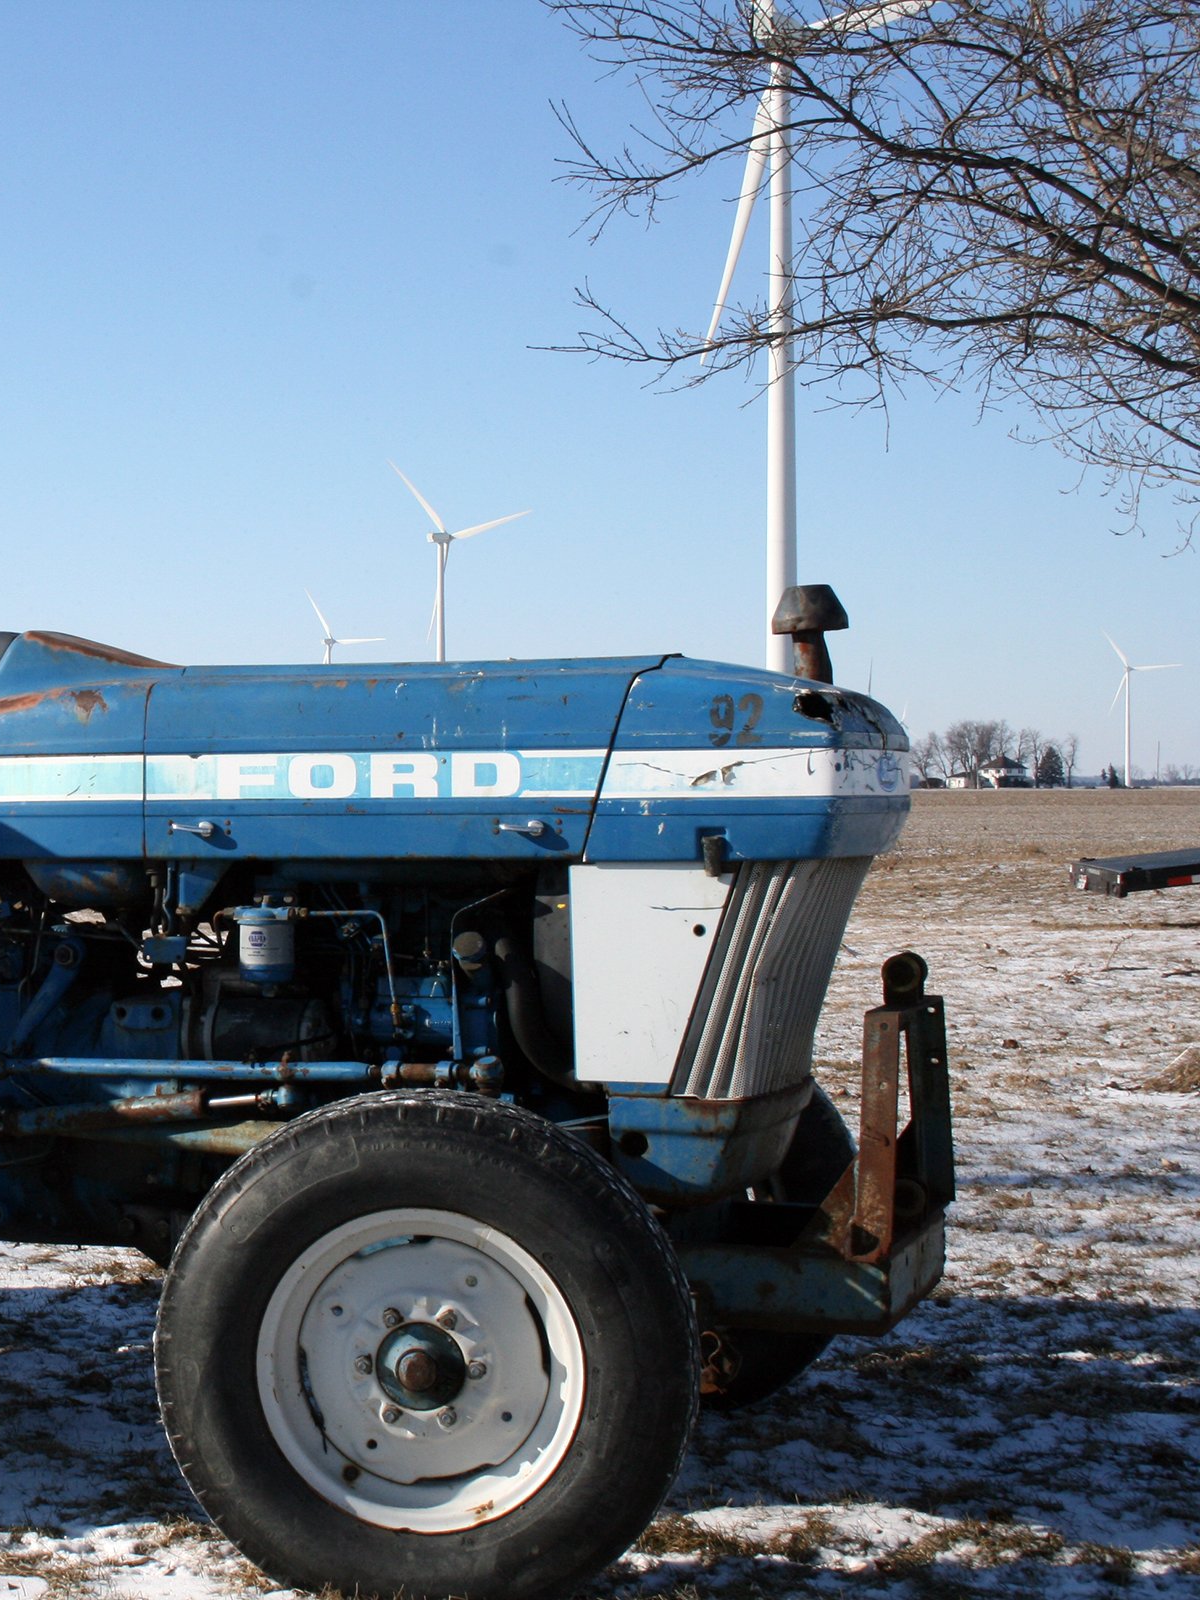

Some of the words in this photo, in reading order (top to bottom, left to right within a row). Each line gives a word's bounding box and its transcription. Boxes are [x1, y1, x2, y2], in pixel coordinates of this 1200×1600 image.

[709, 693, 764, 746] 92
[217, 753, 521, 799] FORD
[360, 1140, 410, 1152] SUPER
